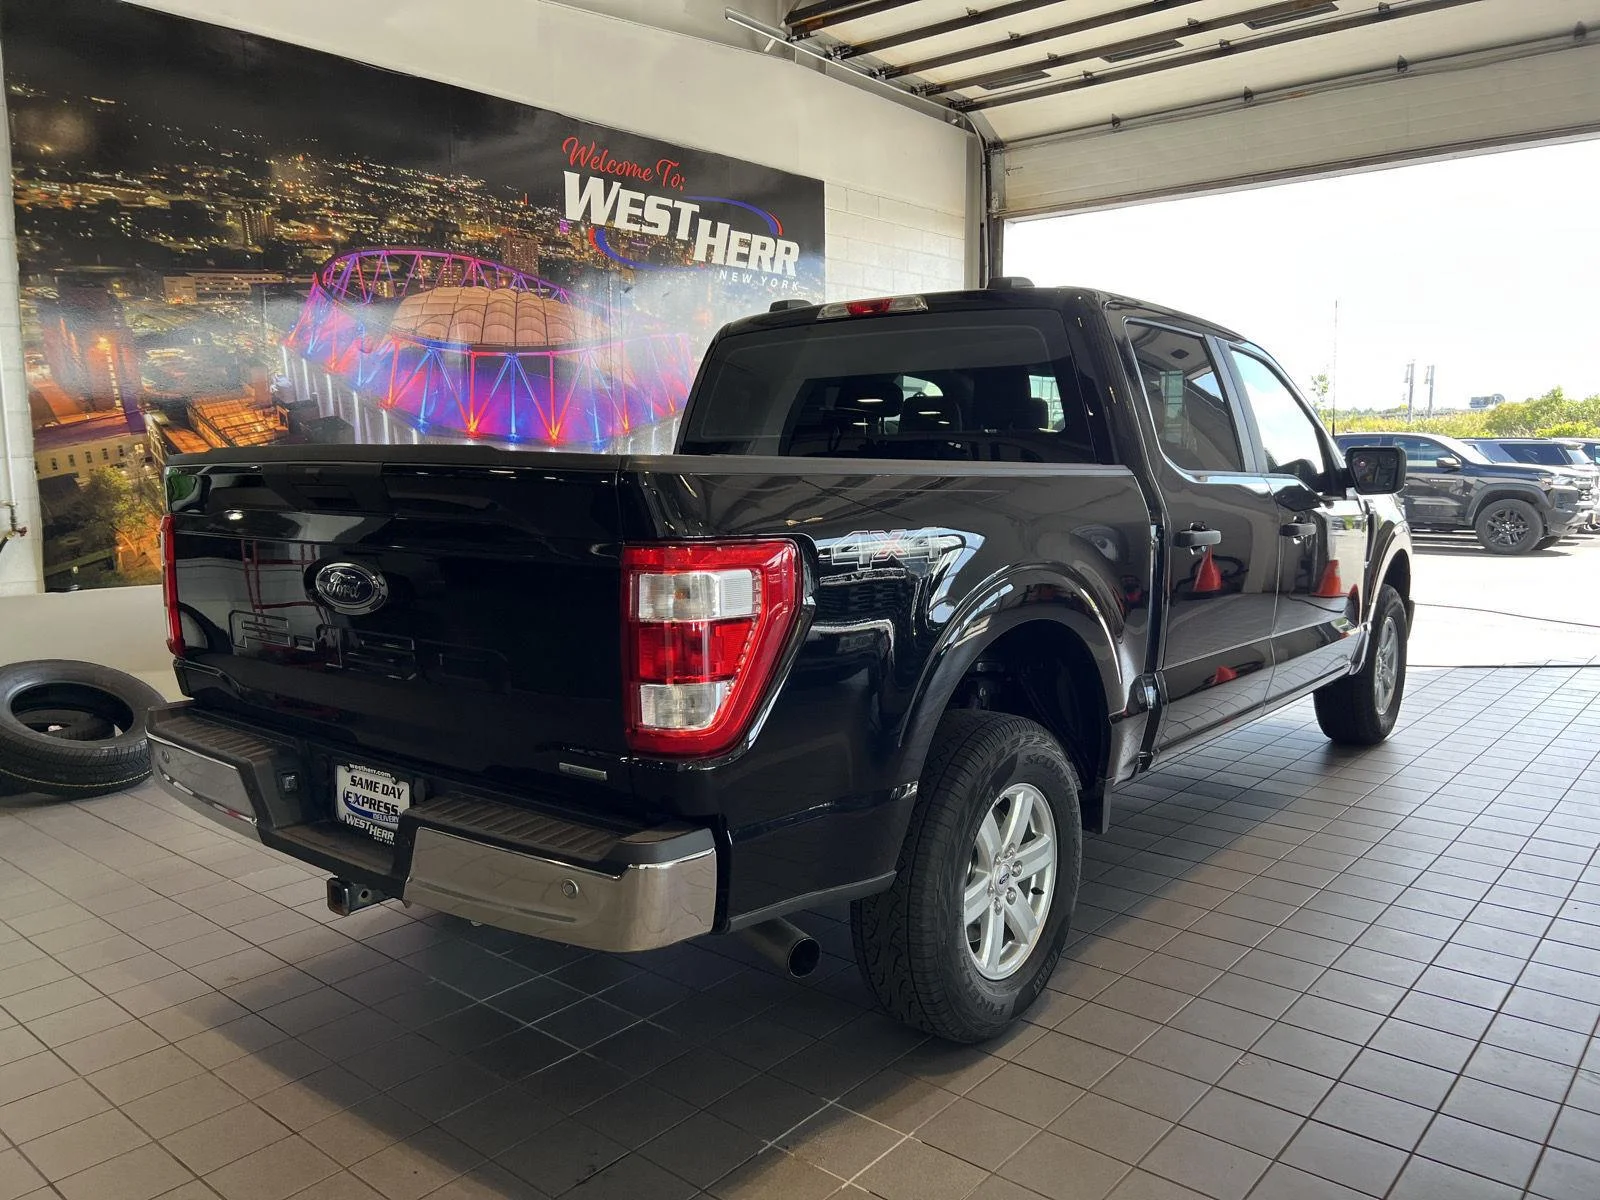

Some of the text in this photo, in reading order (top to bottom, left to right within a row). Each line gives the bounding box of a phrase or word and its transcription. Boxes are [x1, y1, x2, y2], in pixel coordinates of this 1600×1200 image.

[562, 136, 687, 192] Welcome To:
[564, 170, 800, 277] WEST HERR
[720, 269, 800, 292] NEW YORK
[326, 571, 361, 599] Ford
[349, 763, 391, 778] westherr.com
[350, 775, 405, 800] SAME DAY
[346, 790, 399, 816] EXPRESS
[345, 814, 395, 841] WEST HERR
[373, 813, 400, 823] DELIVERY
